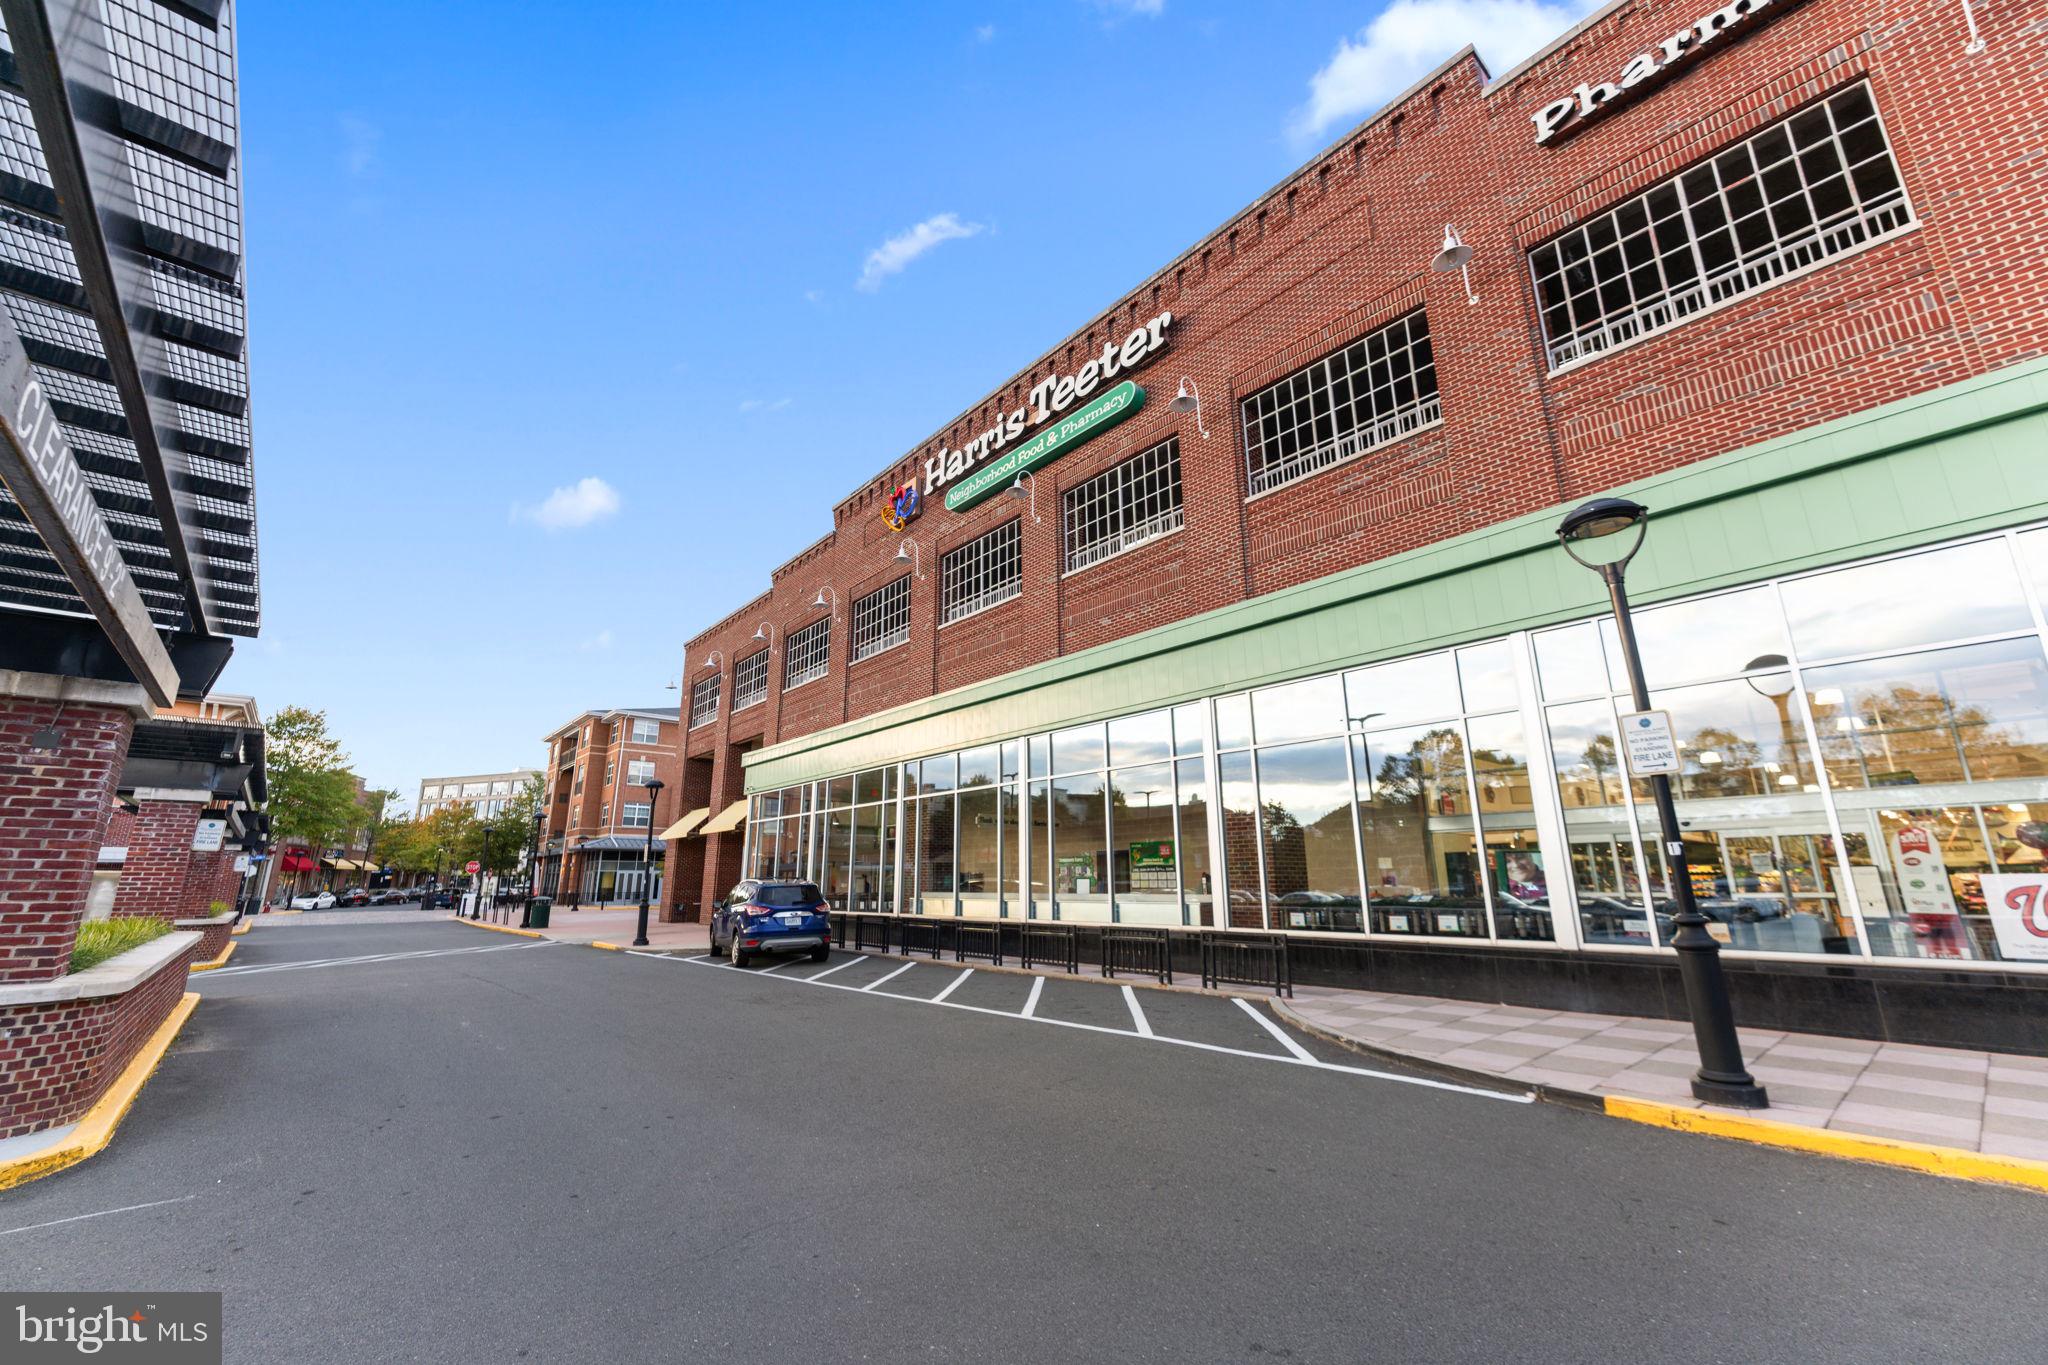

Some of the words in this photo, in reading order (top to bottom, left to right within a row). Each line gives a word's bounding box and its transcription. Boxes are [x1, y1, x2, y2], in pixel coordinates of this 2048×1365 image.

[17, 380, 107, 569] CLEARANCE
[923, 407, 1025, 496] Harris
[1030, 311, 1171, 425] Teeter
[950, 457, 1016, 504] Neighborhood
[1017, 440, 1044, 464] Food
[1047, 431, 1058, 446] &
[1061, 391, 1127, 438] Pharmacy
[1633, 753, 1651, 762] FIRE
[1651, 750, 1674, 761] LANE
